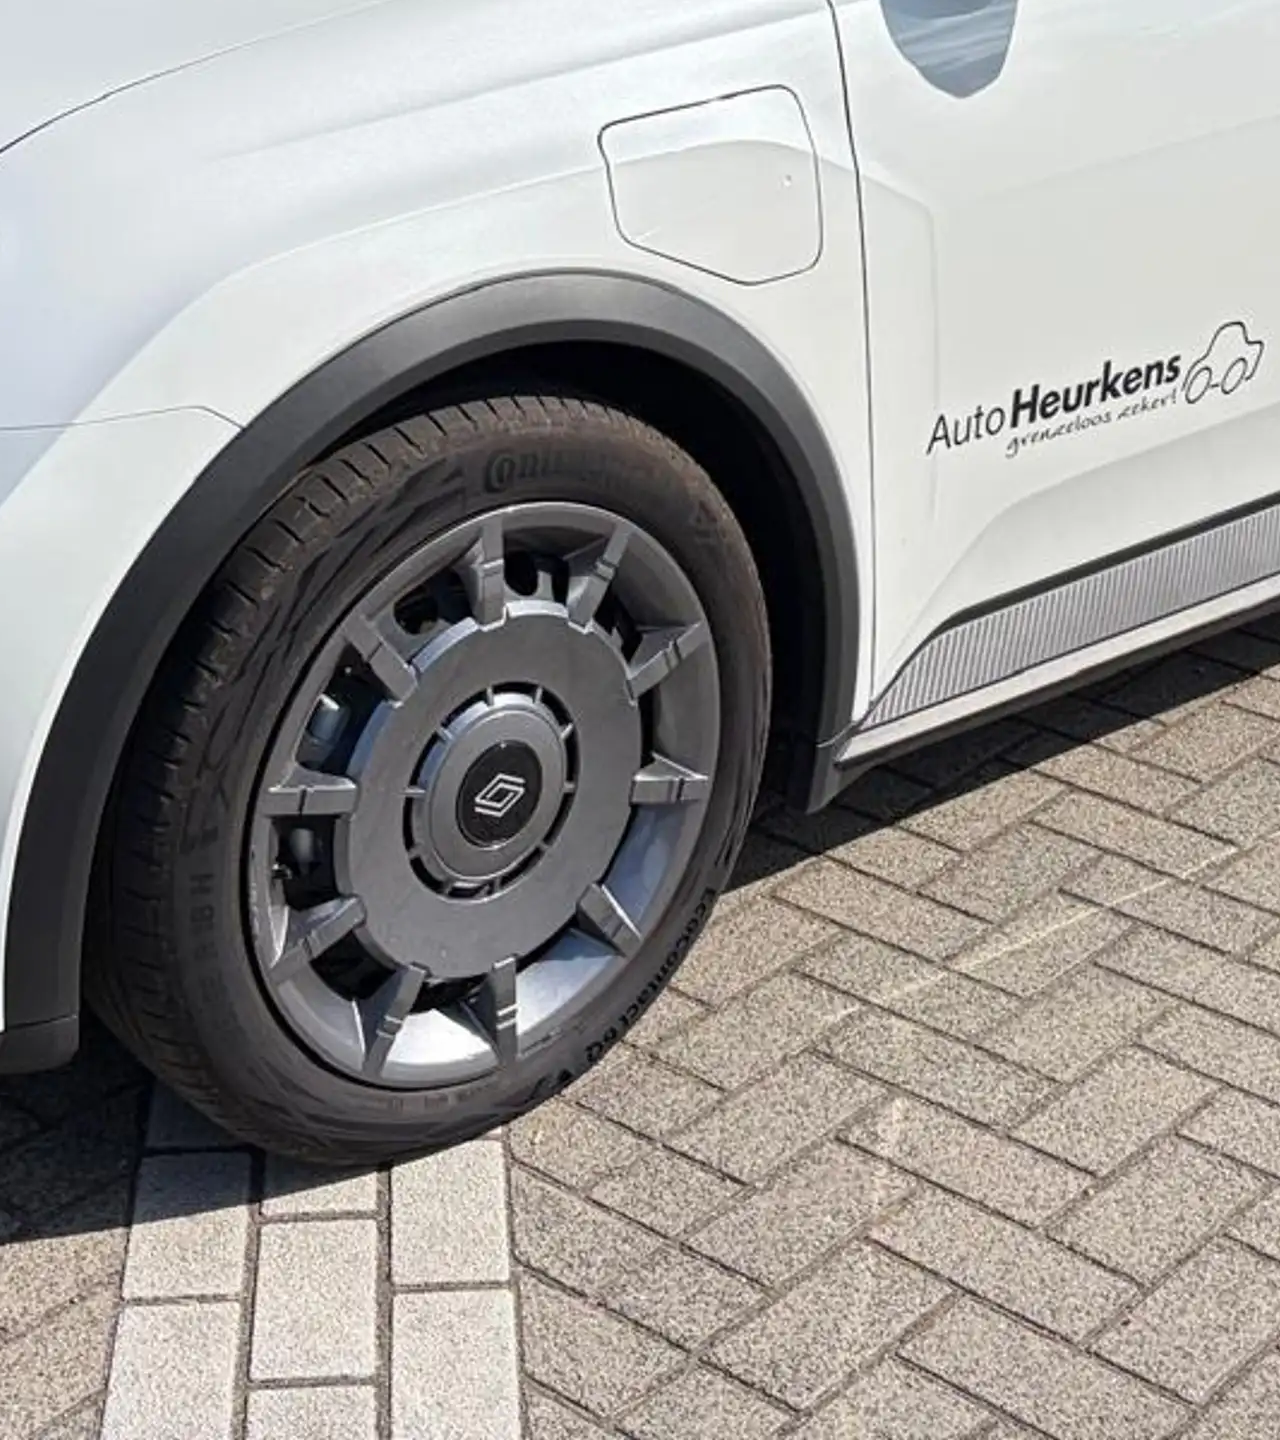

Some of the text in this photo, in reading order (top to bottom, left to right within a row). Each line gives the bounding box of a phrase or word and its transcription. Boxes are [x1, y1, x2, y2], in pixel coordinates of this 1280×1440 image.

[1006, 389, 1177, 458] grenzeloos zeker!
[1010, 353, 1181, 428] Heurkens
